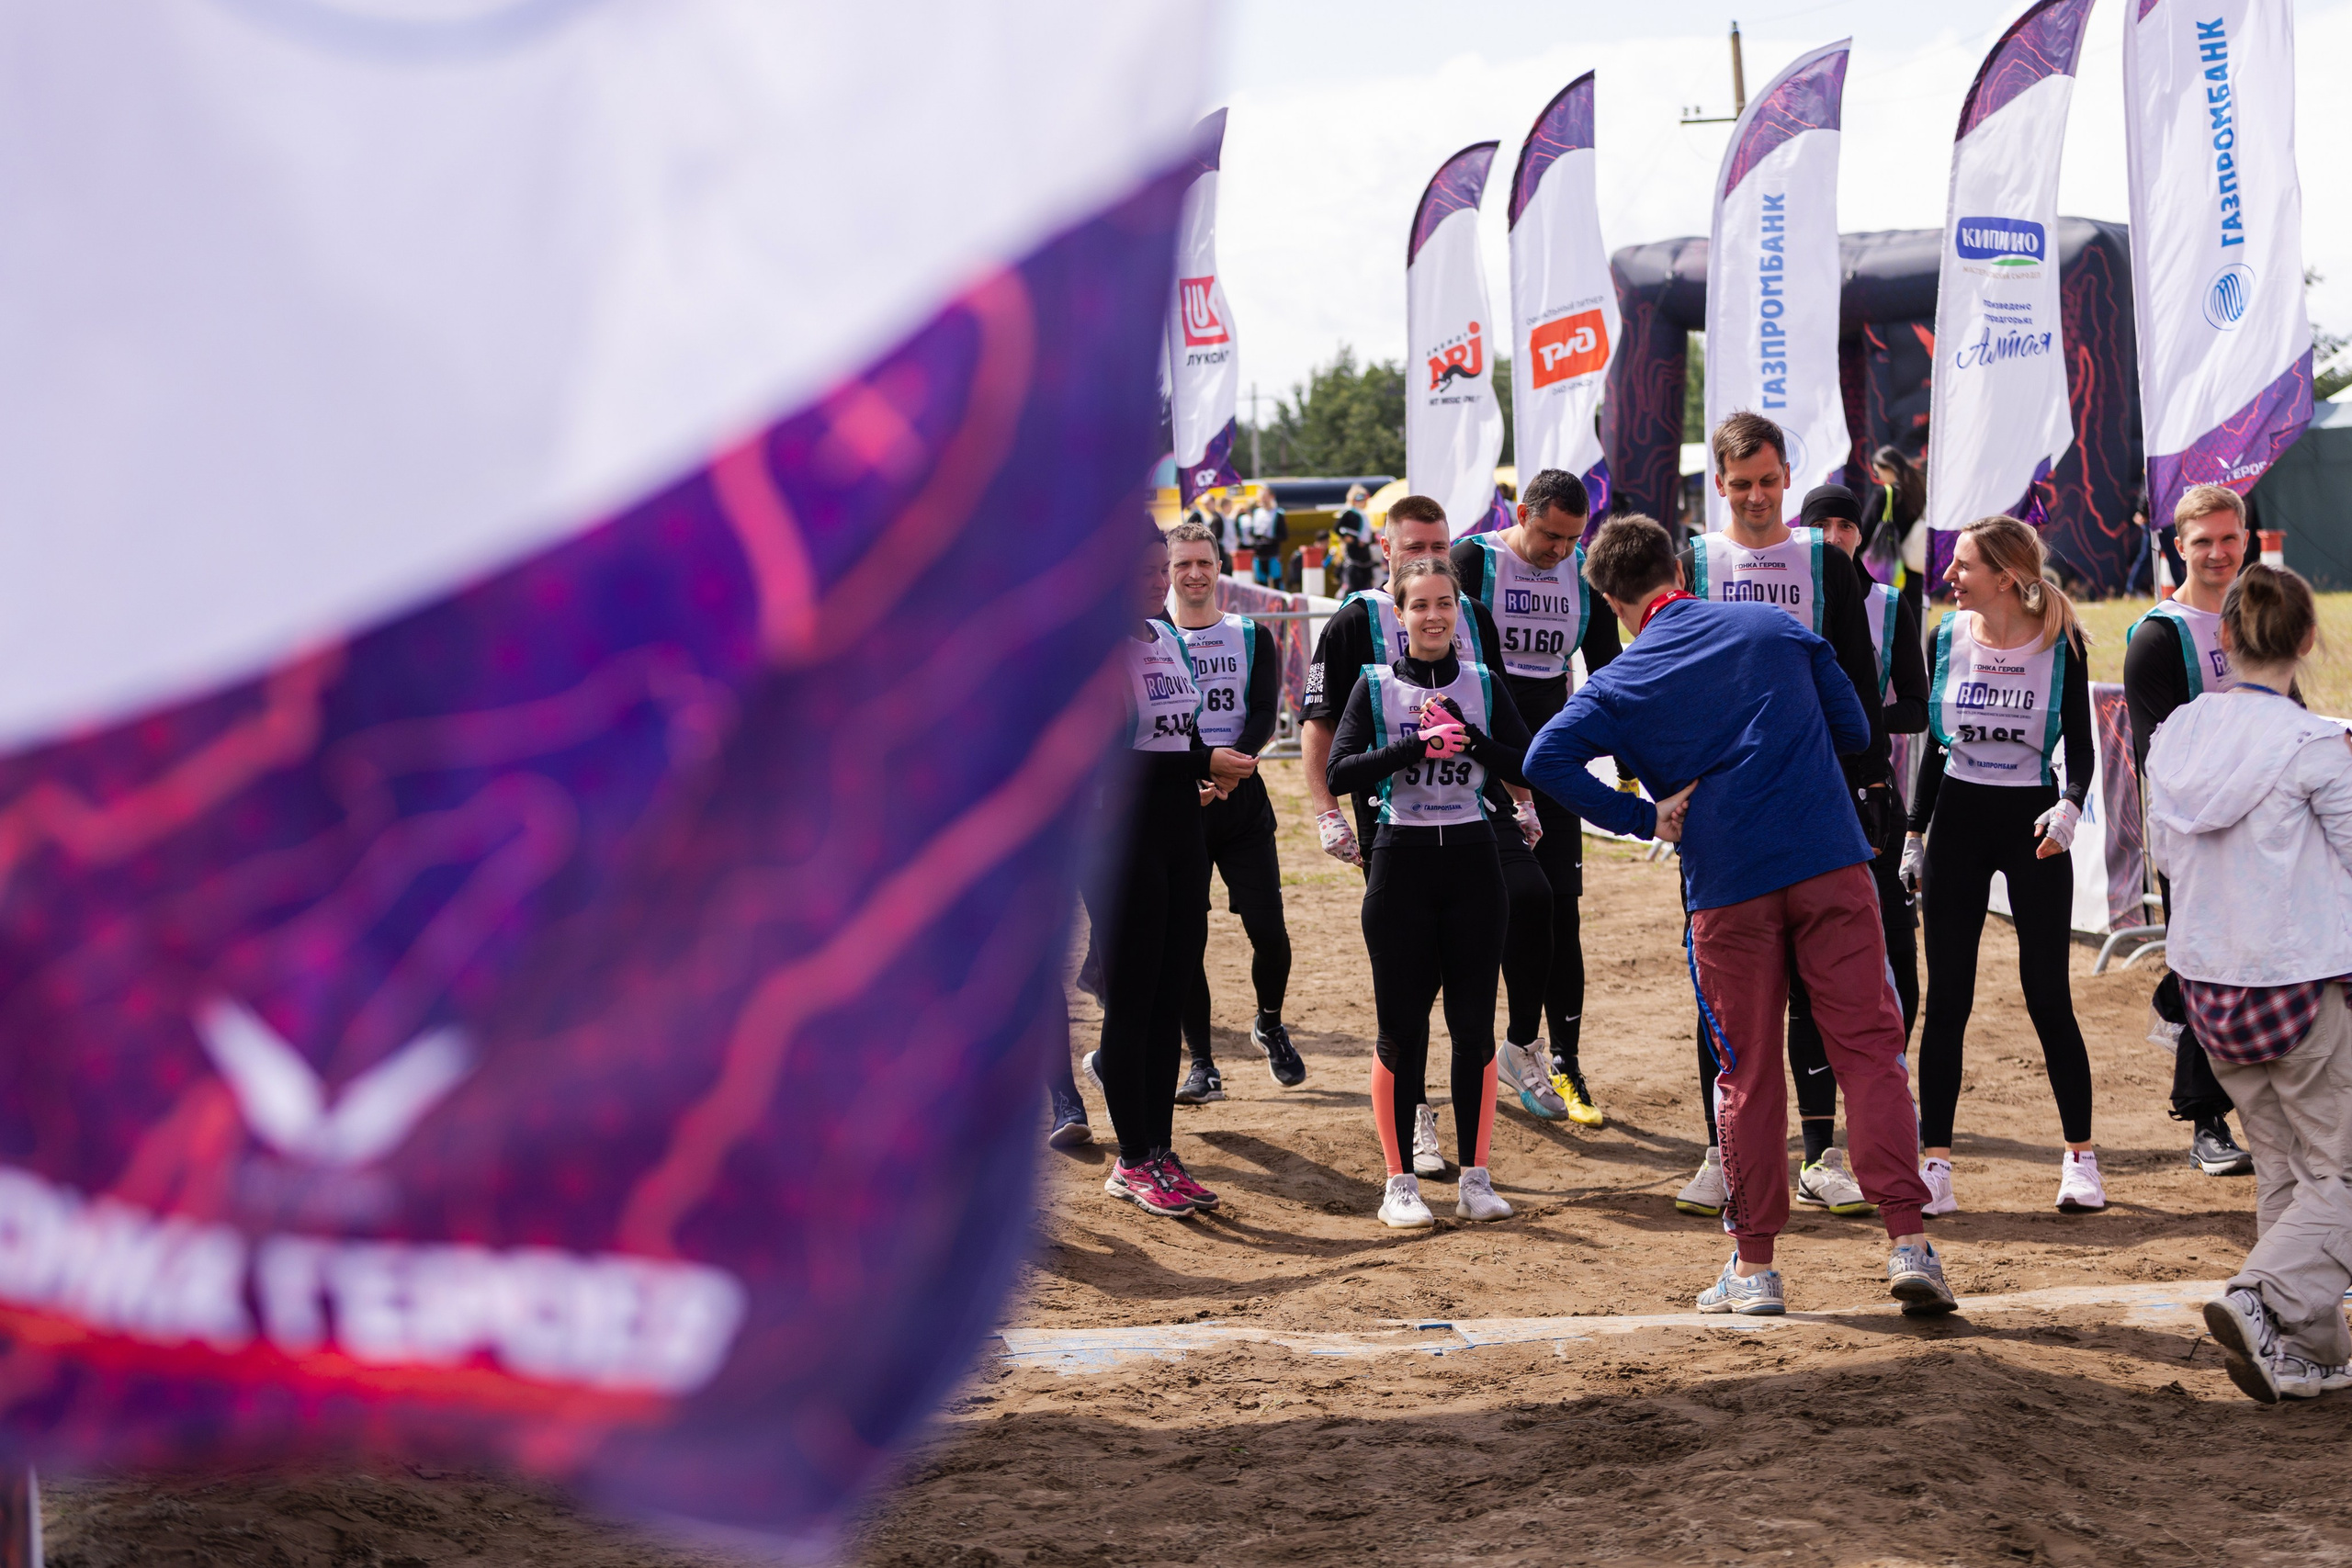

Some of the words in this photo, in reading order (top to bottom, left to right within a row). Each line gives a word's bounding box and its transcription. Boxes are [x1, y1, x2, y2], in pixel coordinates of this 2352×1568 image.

[2196, 17, 2245, 249] ГАЗПРОМБАНК
[1759, 193, 1787, 410] ГАЗПРОМБАНК
[1507, 592, 1569, 615] RODVIG
[1724, 583, 1800, 605] RODVIG
[1504, 626, 1565, 655] 5160
[1194, 656, 1237, 677] DVIG
[1517, 663, 1551, 672] ГАЗПРОМБАНК
[1202, 687, 1235, 712] 63
[1958, 686, 2034, 710] RODVIG
[1405, 759, 1473, 785] 5159
[1976, 761, 2018, 770] ГАЗПРОМБАНК
[1423, 803, 1463, 811] ГАЗПРОМБАНК
